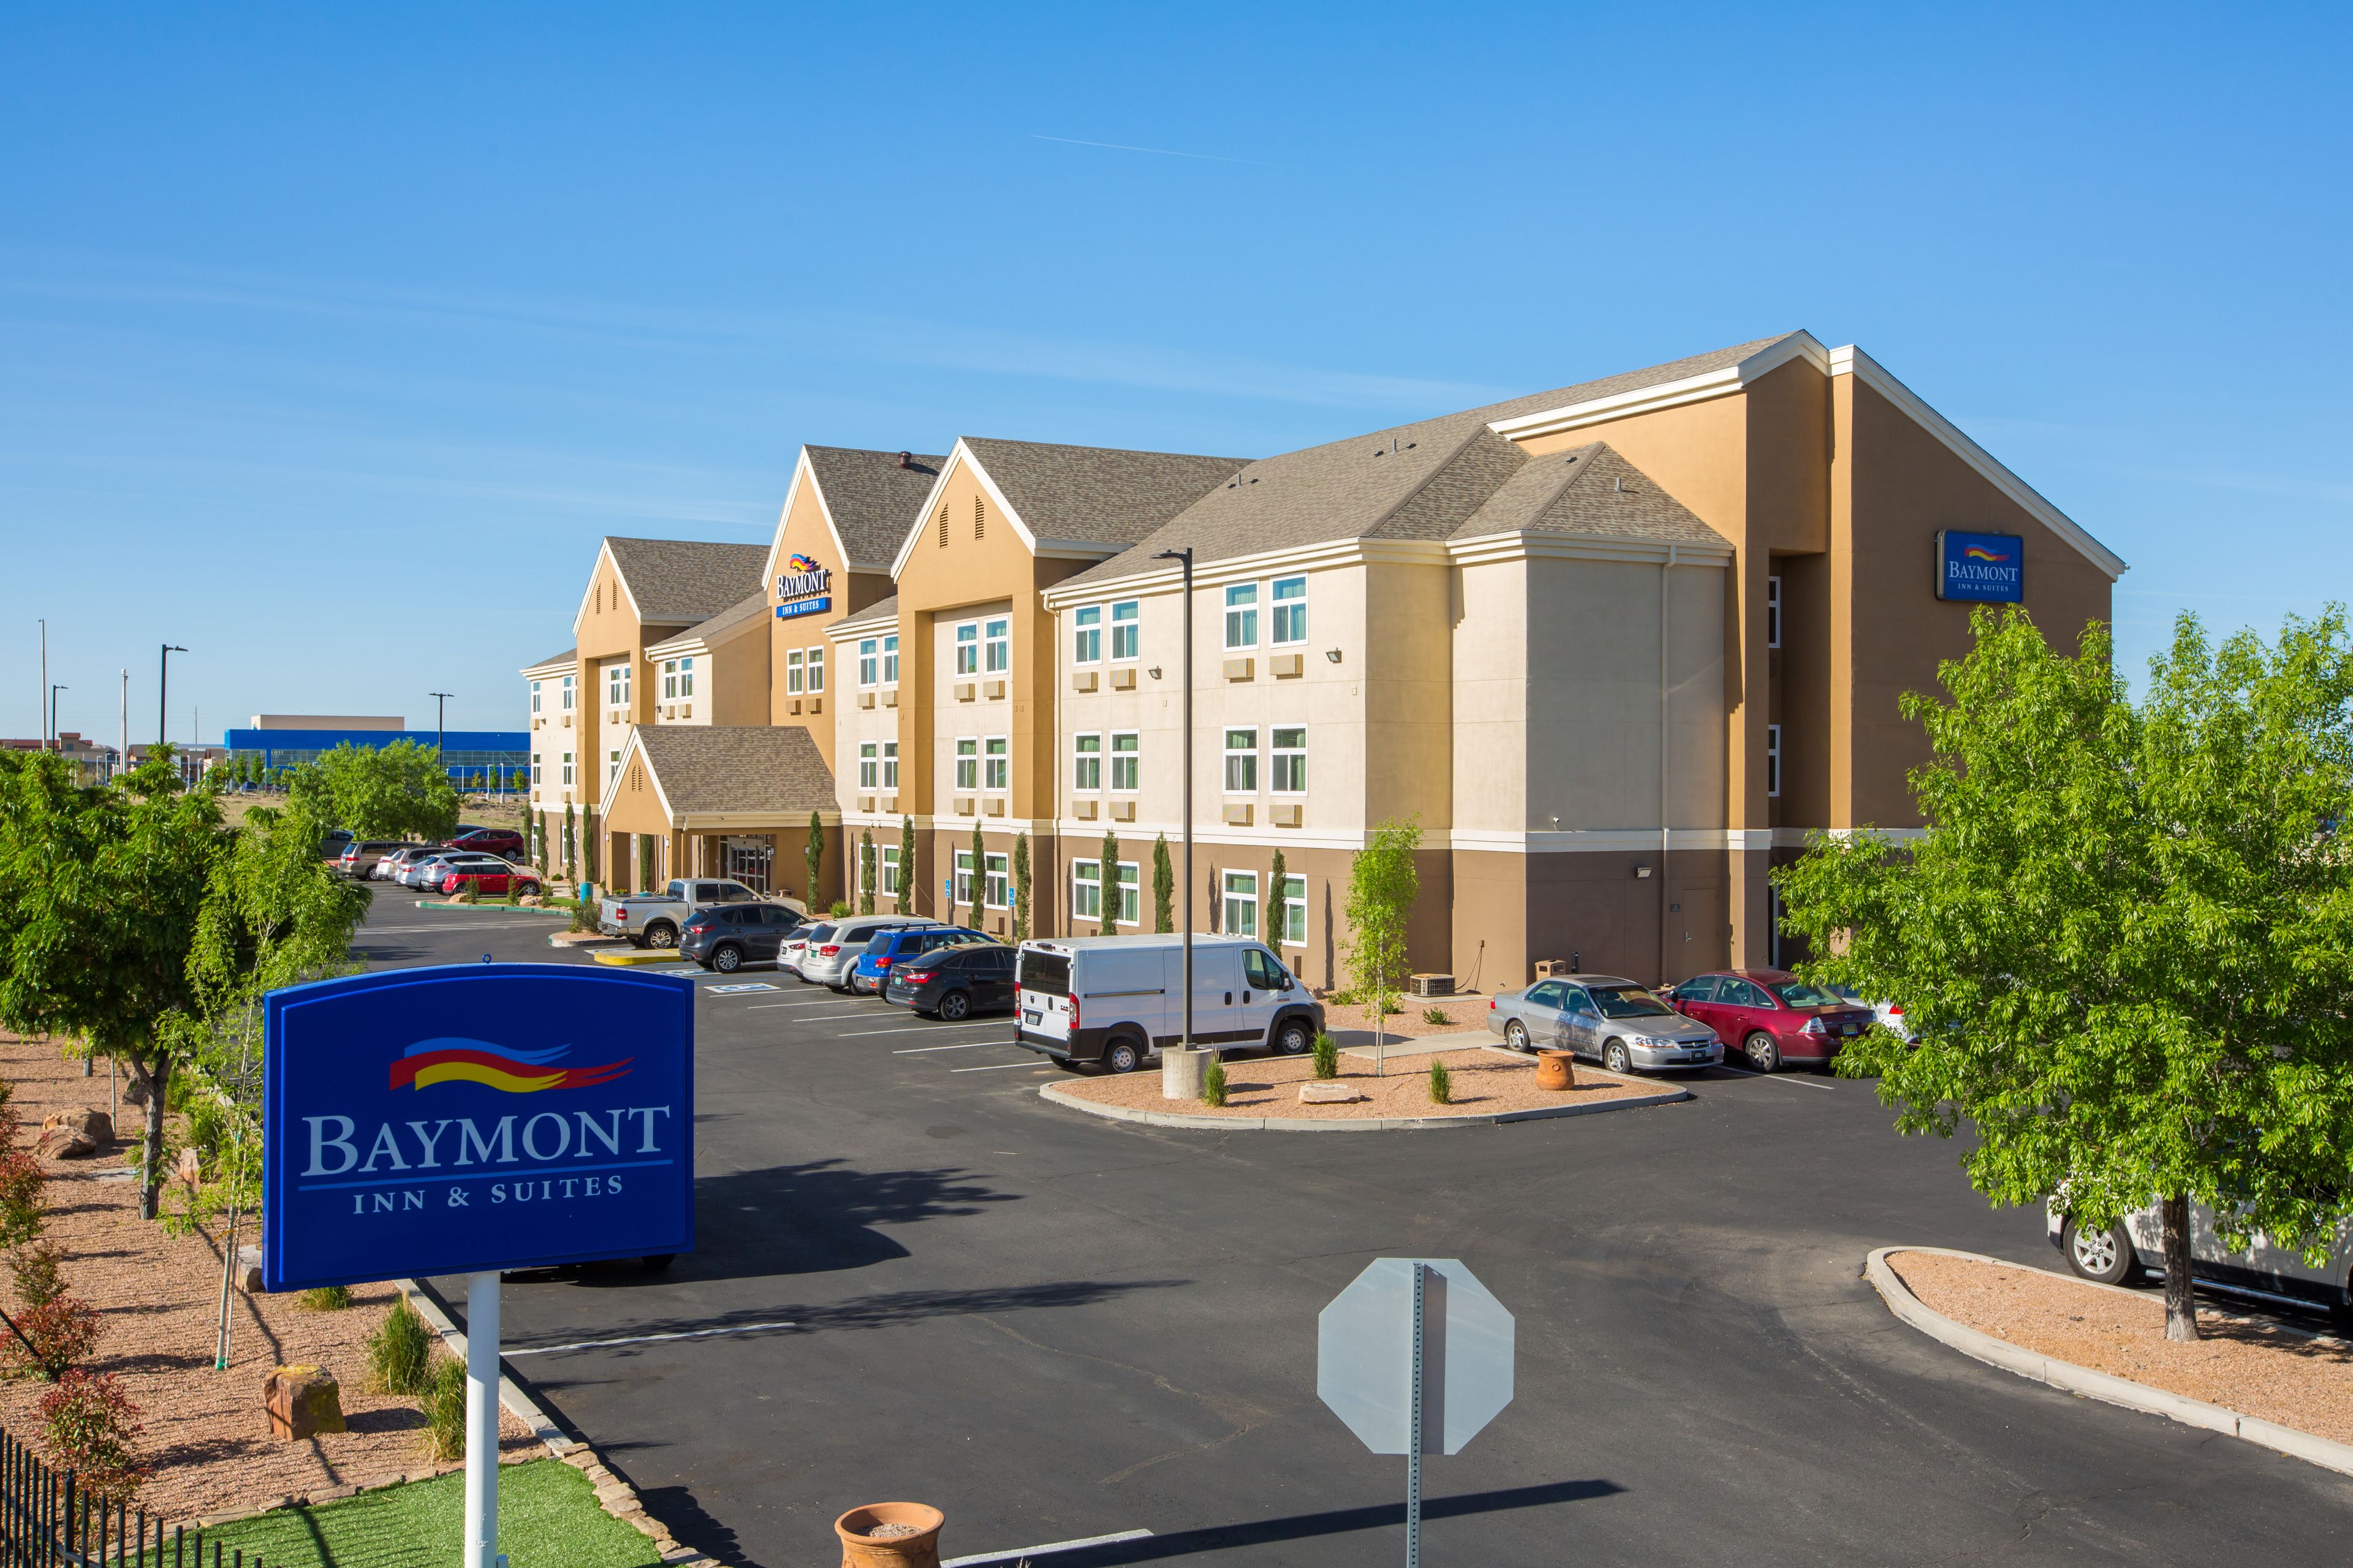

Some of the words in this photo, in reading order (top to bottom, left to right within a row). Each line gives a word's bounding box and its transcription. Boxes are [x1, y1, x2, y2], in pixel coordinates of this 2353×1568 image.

[776, 569, 826, 599] BAYMONT
[1949, 561, 2018, 581] BAYMONT
[782, 605, 792, 615] INN
[794, 604, 798, 613] &
[800, 600, 819, 612] SUITES
[300, 1105, 670, 1176] BAYMONT
[354, 1190, 426, 1214] INN
[447, 1186, 469, 1206] &
[491, 1175, 623, 1203] SUITES
